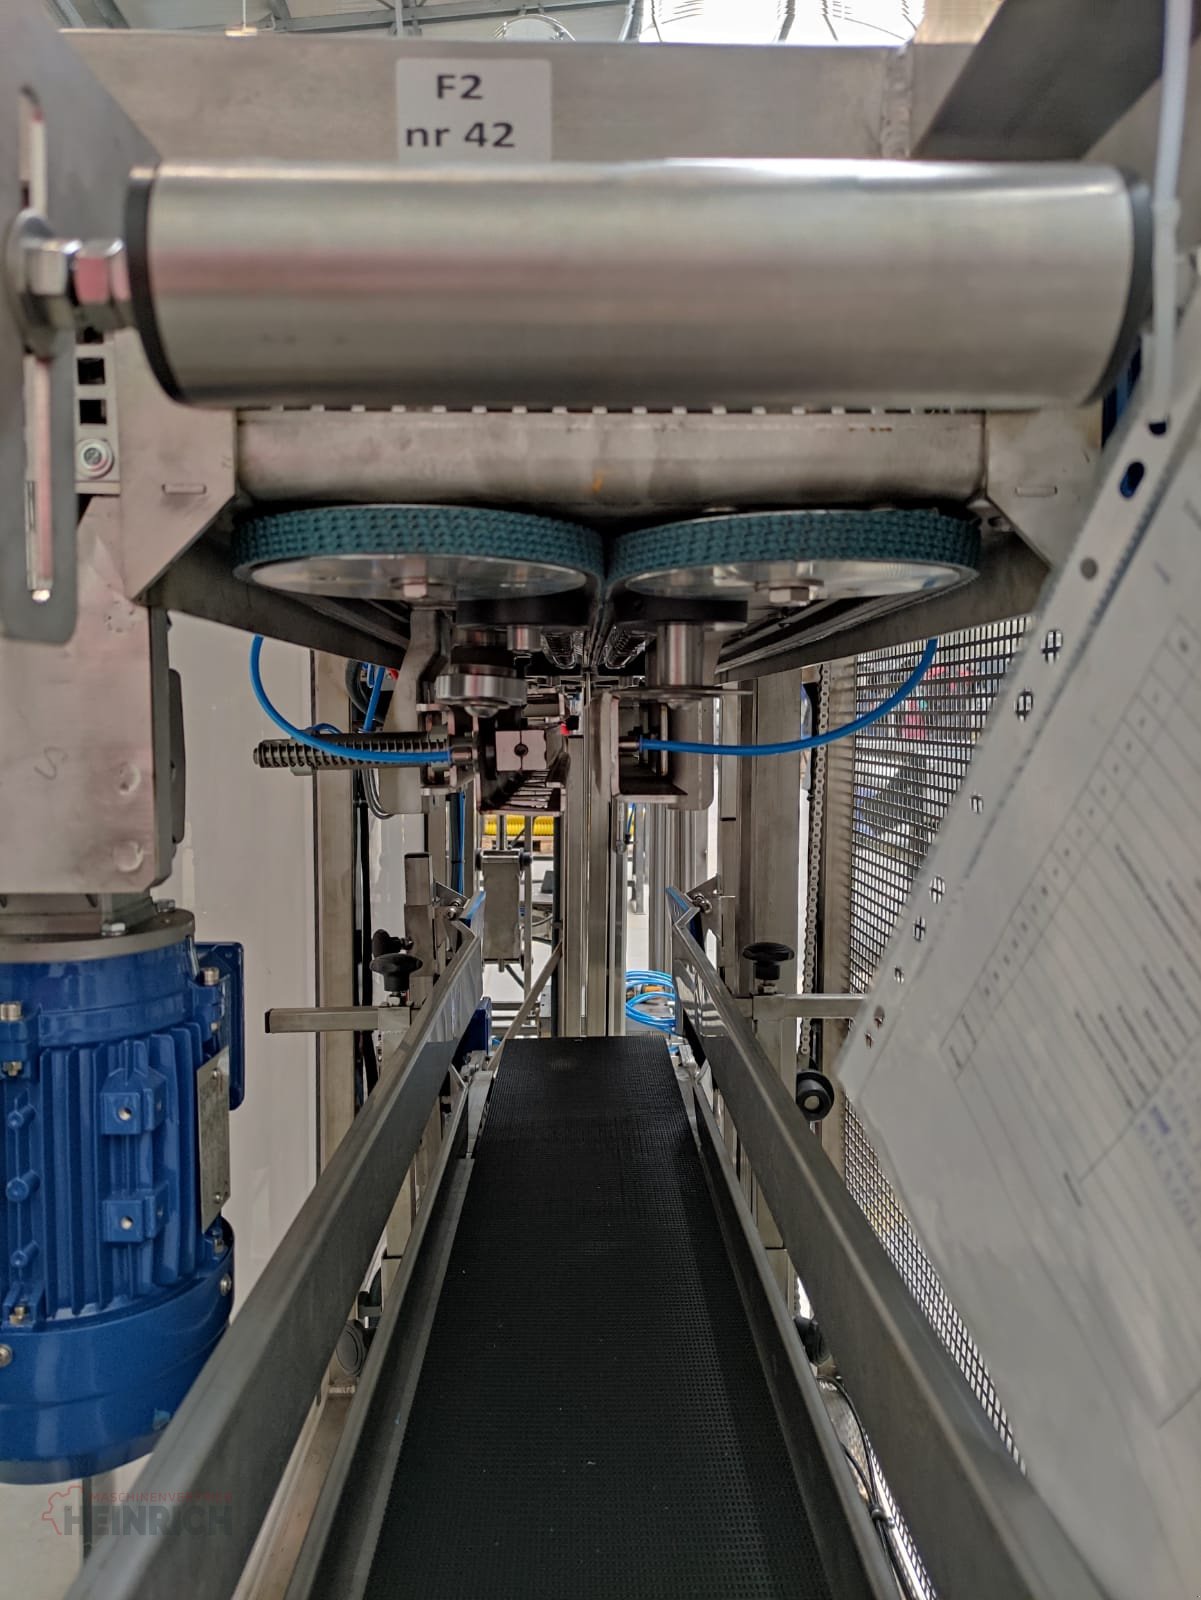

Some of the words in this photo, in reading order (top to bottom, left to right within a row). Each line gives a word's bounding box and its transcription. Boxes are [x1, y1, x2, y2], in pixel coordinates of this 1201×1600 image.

[436, 73, 483, 100] F2
[406, 127, 450, 147] nr
[463, 122, 515, 148] 42
